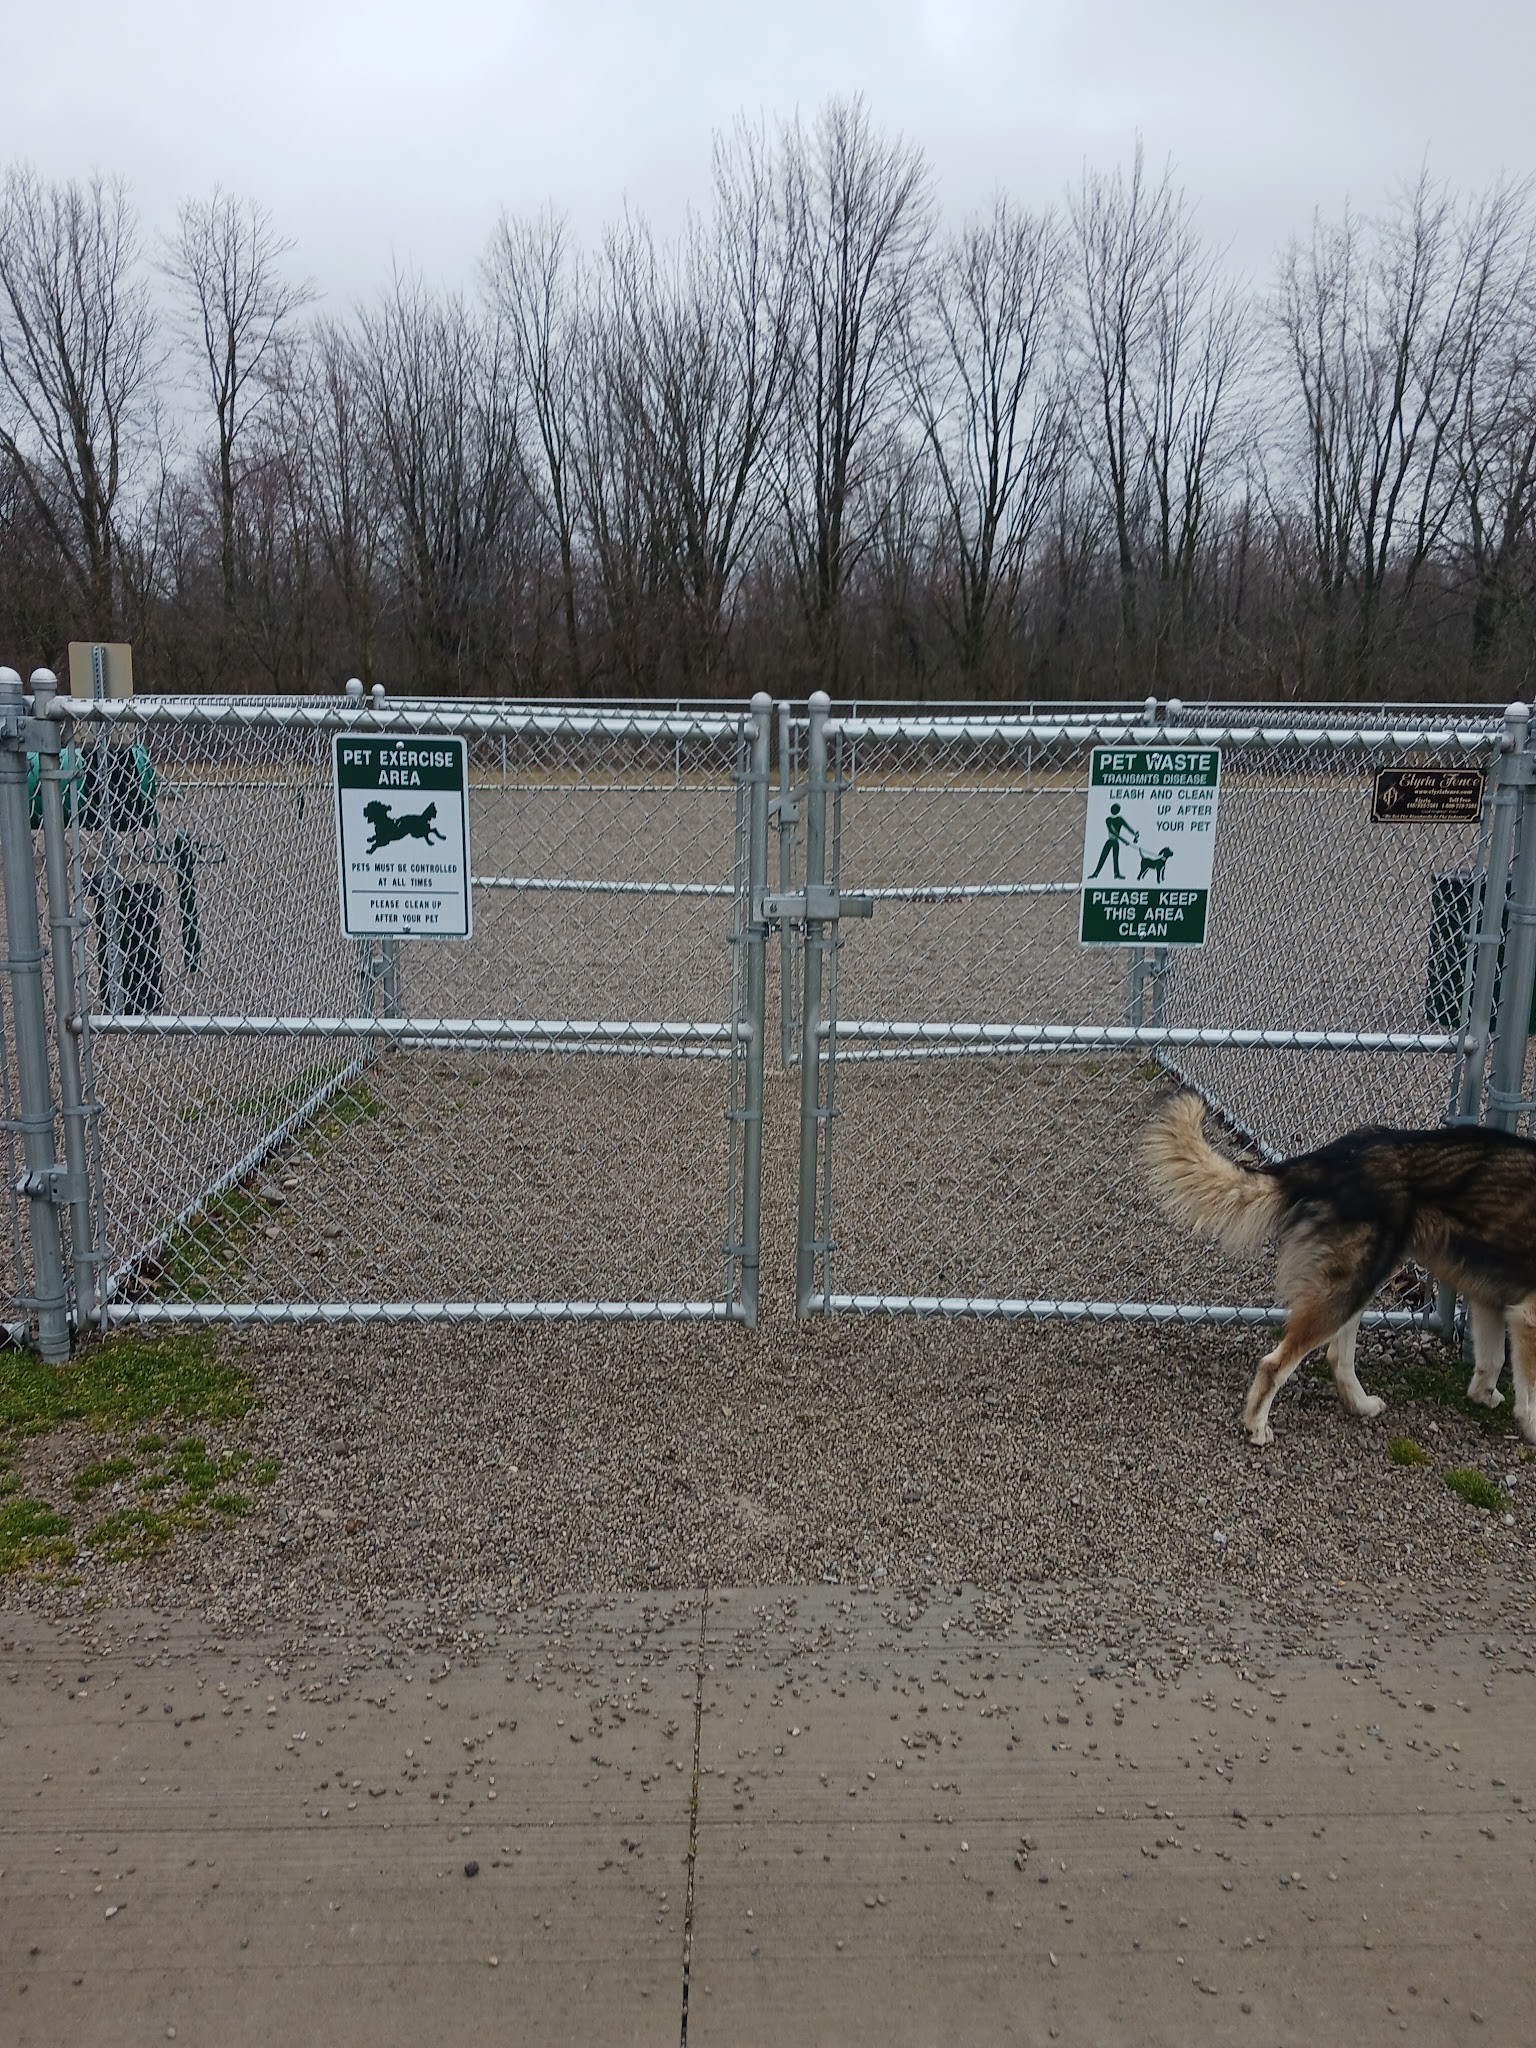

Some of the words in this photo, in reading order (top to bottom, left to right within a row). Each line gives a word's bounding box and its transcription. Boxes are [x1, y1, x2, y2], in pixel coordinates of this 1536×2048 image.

[343, 750, 372, 765] PET
[380, 751, 453, 767] EXERCISE
[1100, 754, 1137, 770] PET
[1146, 753, 1211, 771] WASTE
[378, 770, 420, 785] AREA
[1102, 774, 1159, 784] TRANSMITS
[1163, 774, 1207, 784] DISEASE
[1399, 773, 1436, 789] Elyria
[1440, 773, 1480, 788] Fence
[1110, 789, 1144, 799] LEASH
[1150, 789, 1172, 799] AND
[1178, 790, 1213, 799] CLEAN
[1157, 805, 1171, 815] UP
[1177, 805, 1212, 815] AFTER
[1156, 821, 1184, 831] YOUR
[1190, 821, 1211, 832] PET
[352, 863, 370, 872] PETS
[374, 863, 394, 872] MUST
[398, 864, 407, 872] BE
[410, 864, 457, 873] CONTROLLED
[378, 878, 387, 886] AT
[392, 878, 406, 886] ALL
[411, 878, 432, 887] TIMES
[1092, 892, 1148, 905] PLEASE
[1159, 892, 1197, 905] KEEP
[370, 900, 399, 909] PLEASE
[404, 900, 429, 909] CLEAN
[432, 901, 441, 909] UP
[375, 914, 398, 922] AFTER
[402, 914, 421, 923] YOUR
[425, 915, 439, 923] PET
[1104, 907, 1136, 921] THIS
[1144, 908, 1184, 921] AREA
[1119, 923, 1167, 937] CLEAN
